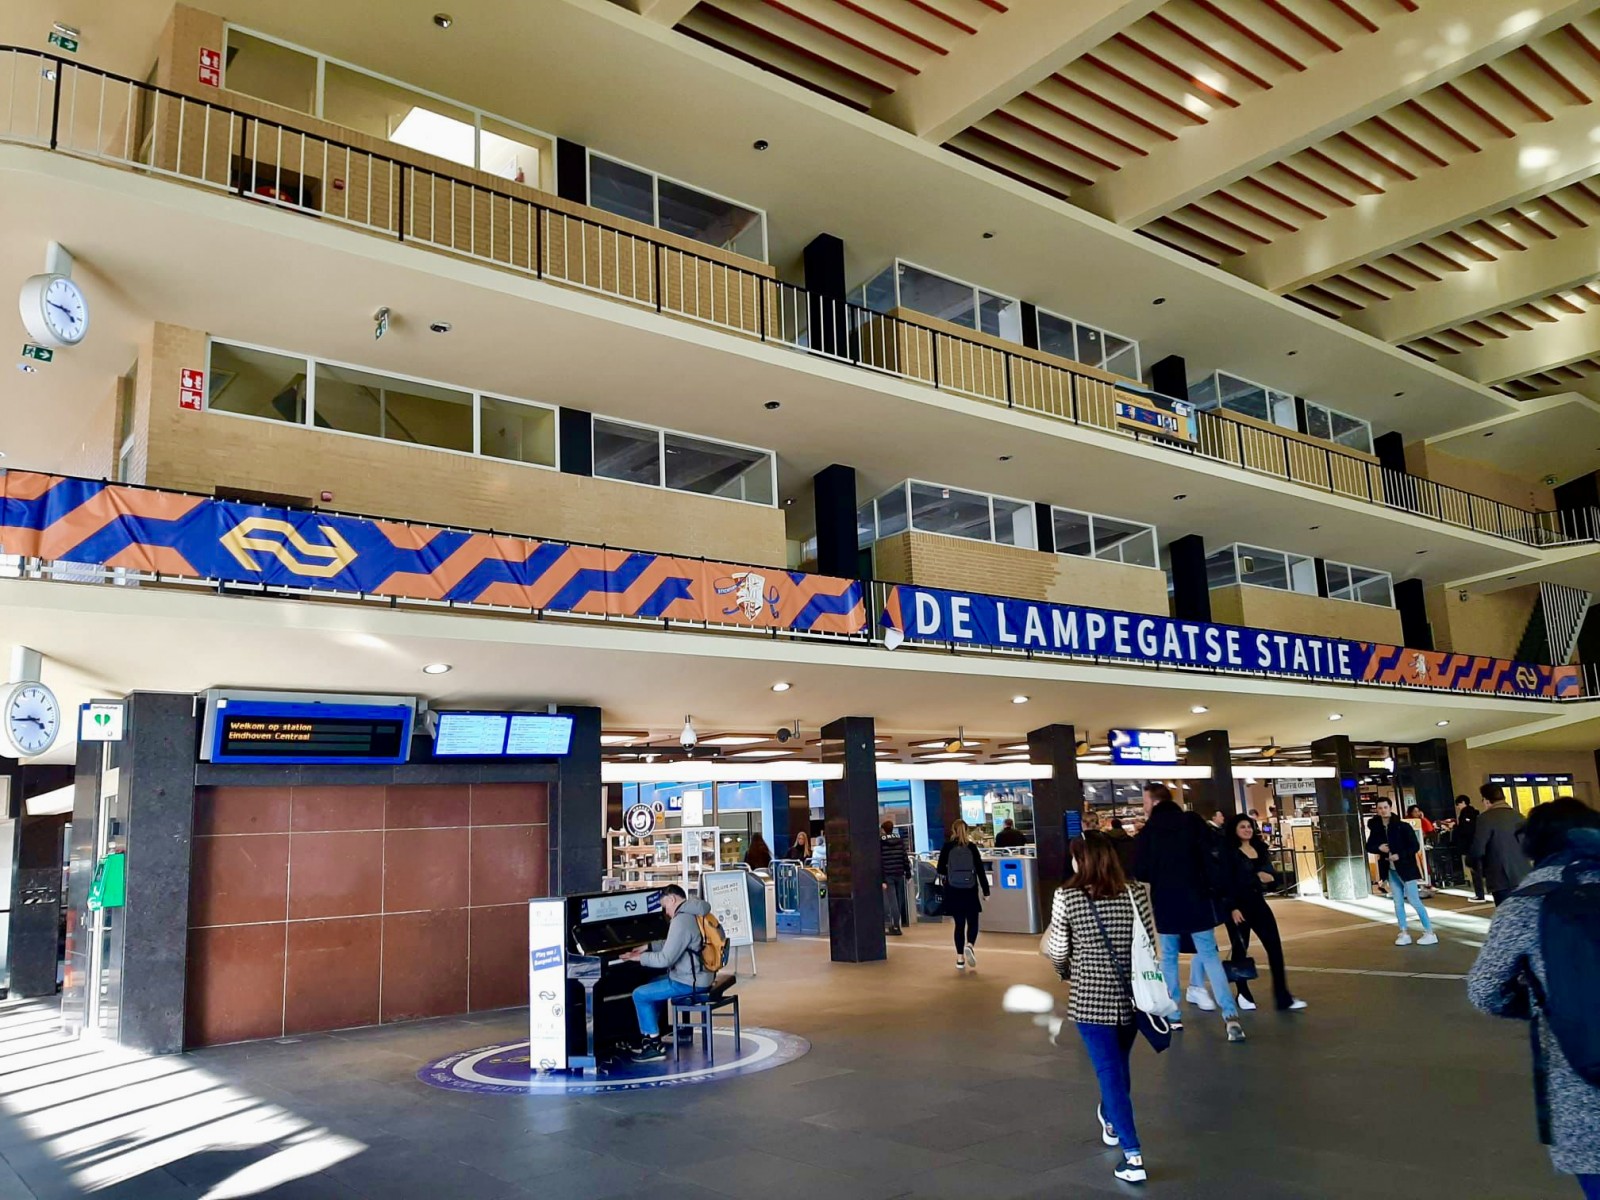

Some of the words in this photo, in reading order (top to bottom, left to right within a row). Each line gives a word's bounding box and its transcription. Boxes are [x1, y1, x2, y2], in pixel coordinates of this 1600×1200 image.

[915, 591, 973, 639] DE
[996, 602, 1243, 665] LAMPEGATSE
[1256, 633, 1352, 676] STATIE
[230, 722, 264, 731] Welkom
[268, 723, 279, 732] op
[282, 722, 312, 731] station
[228, 731, 272, 741] Eindhoven
[274, 732, 311, 742] Centraal
